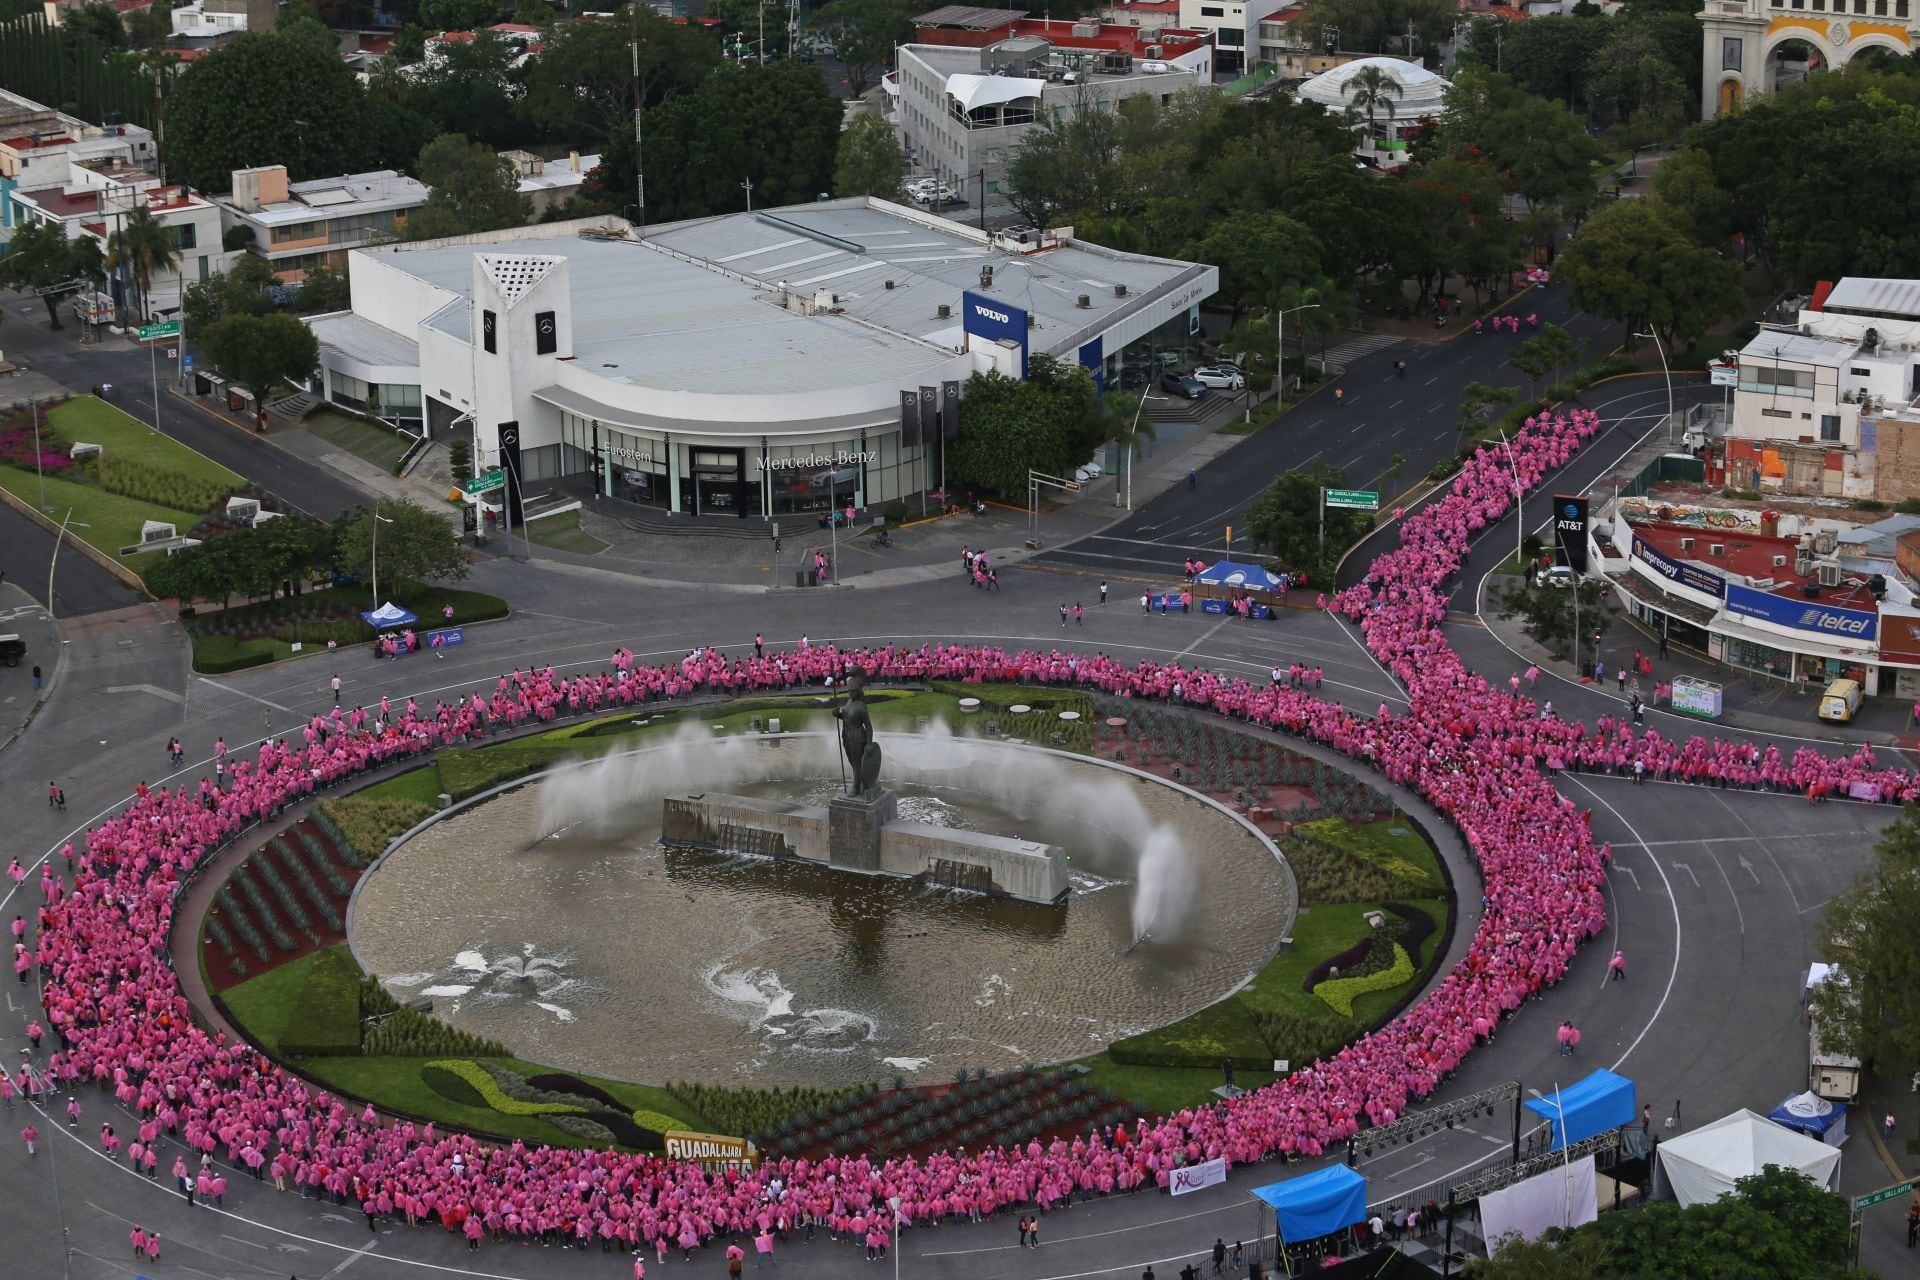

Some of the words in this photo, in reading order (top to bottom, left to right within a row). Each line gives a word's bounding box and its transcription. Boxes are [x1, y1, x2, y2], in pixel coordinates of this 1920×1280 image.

[975, 305, 1009, 324] VOLVO
[605, 441, 651, 463] Eurostern
[755, 450, 876, 471] Mercedes-Benz
[1557, 520, 1583, 531] AT&T
[1642, 546, 1678, 577] imprecopy
[1817, 612, 1870, 634] telcel
[667, 1139, 742, 1160] GUADALAJARA
[1884, 1183, 1912, 1198] VALLARTA
